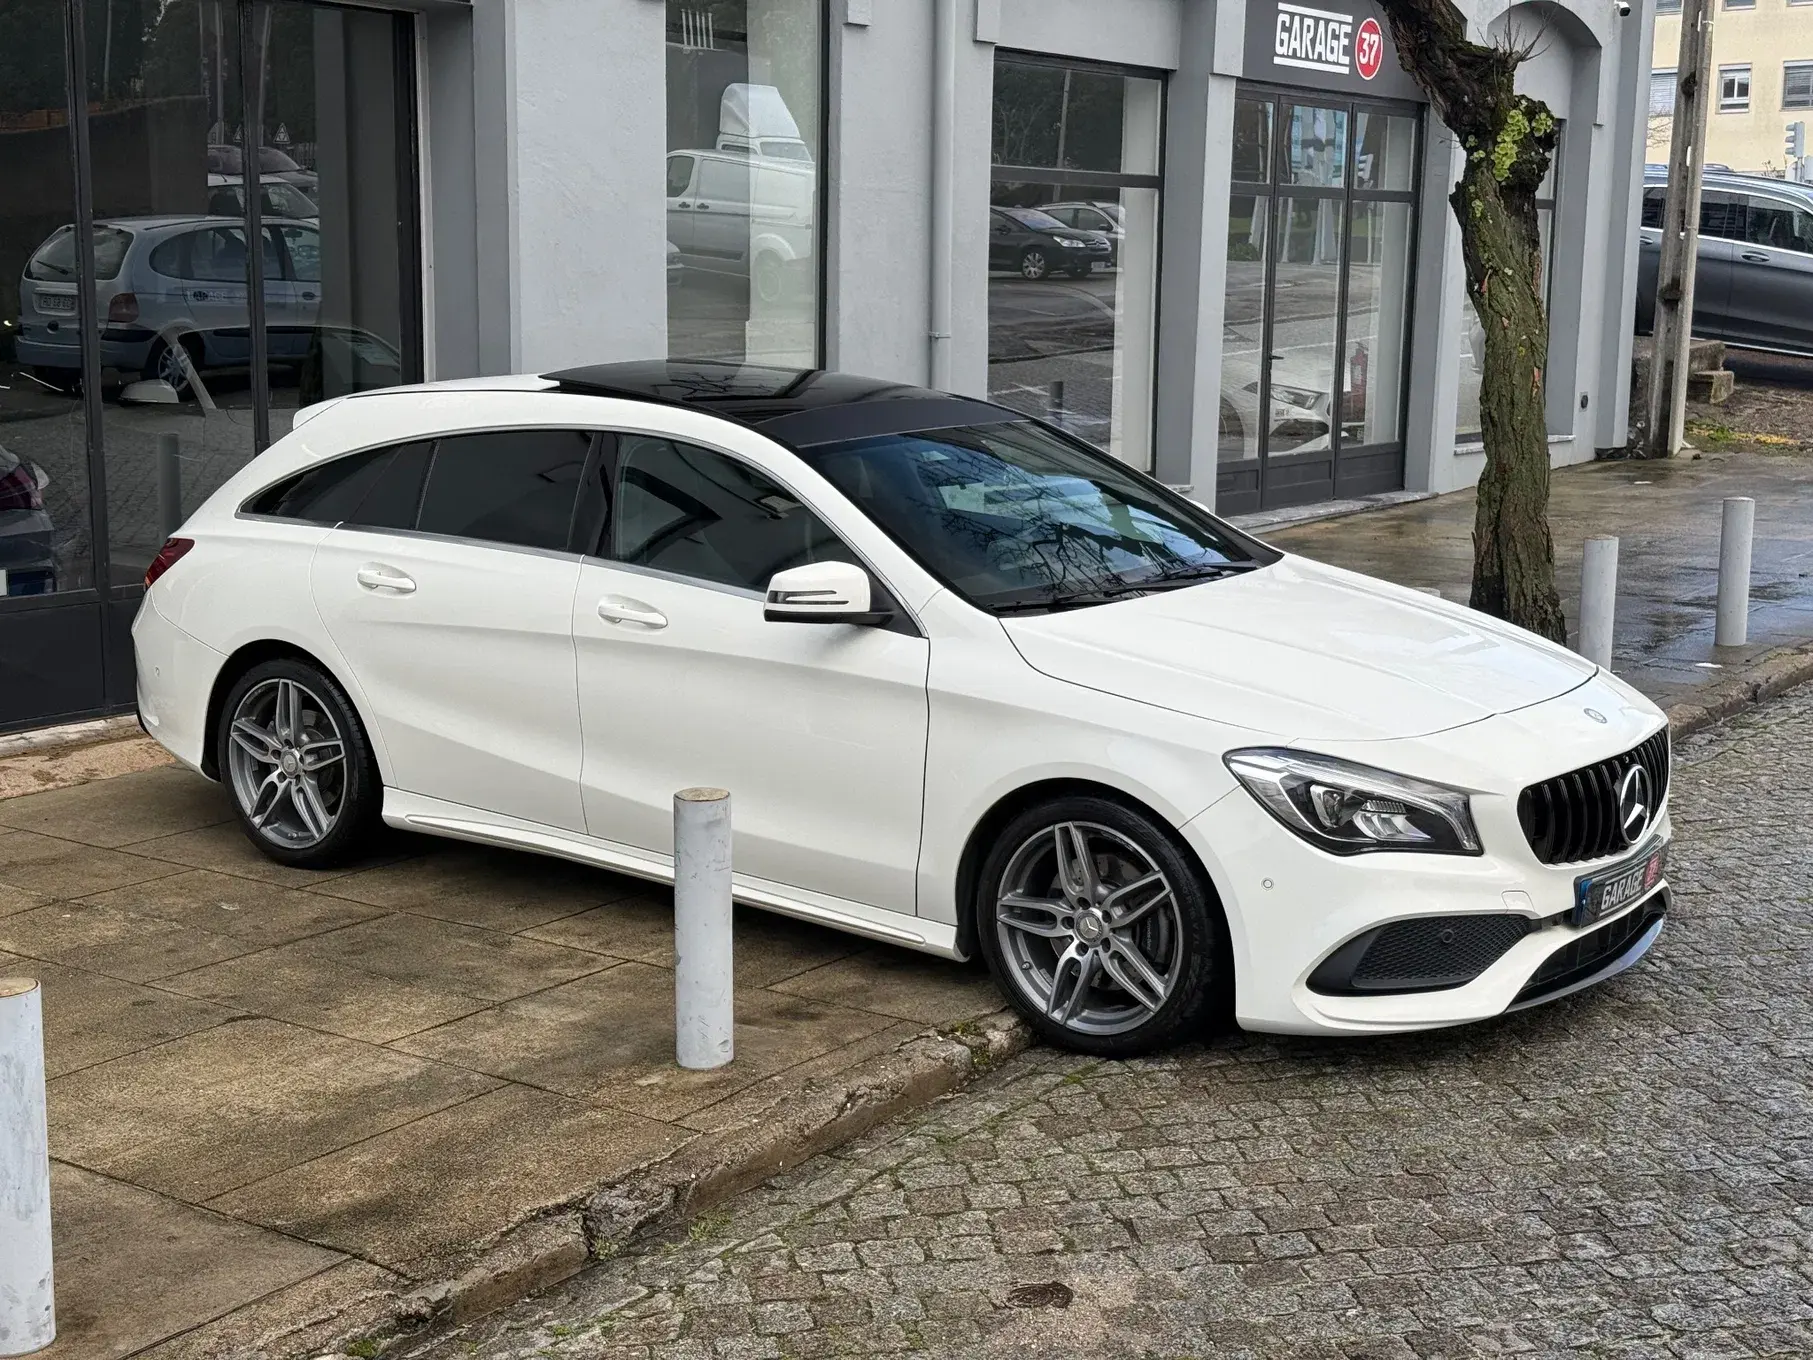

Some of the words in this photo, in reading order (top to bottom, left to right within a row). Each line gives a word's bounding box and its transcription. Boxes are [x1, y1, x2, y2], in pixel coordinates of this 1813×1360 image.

[1275, 13, 1352, 65] GARAGE
[1359, 32, 1379, 66] 37
[1601, 866, 1646, 910] GARAGE
